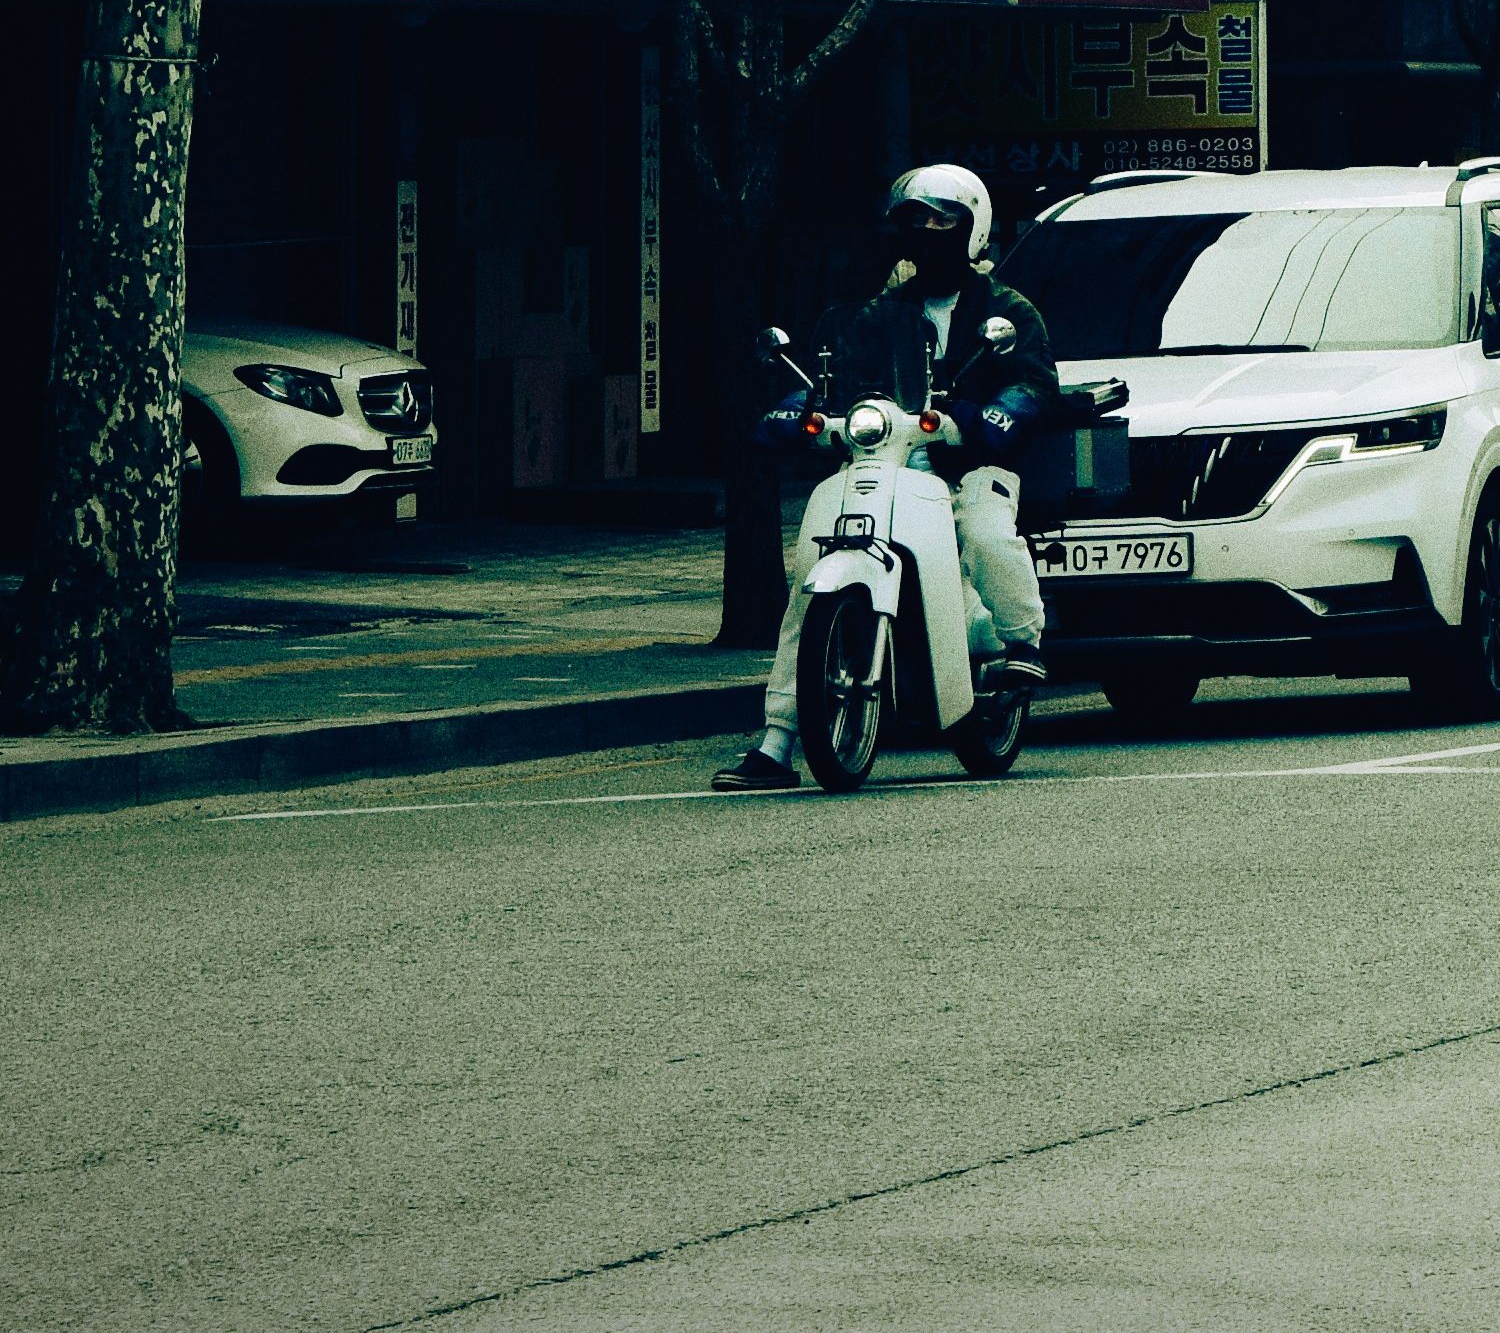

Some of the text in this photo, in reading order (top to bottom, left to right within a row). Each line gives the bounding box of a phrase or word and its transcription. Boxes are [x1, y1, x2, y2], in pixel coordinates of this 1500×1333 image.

[1217, 13, 1254, 115] 철물
[1103, 136, 1254, 154] 02) 886-0203
[1103, 155, 1255, 172] 010-5248-2558
[1116, 541, 1184, 570] 7976
